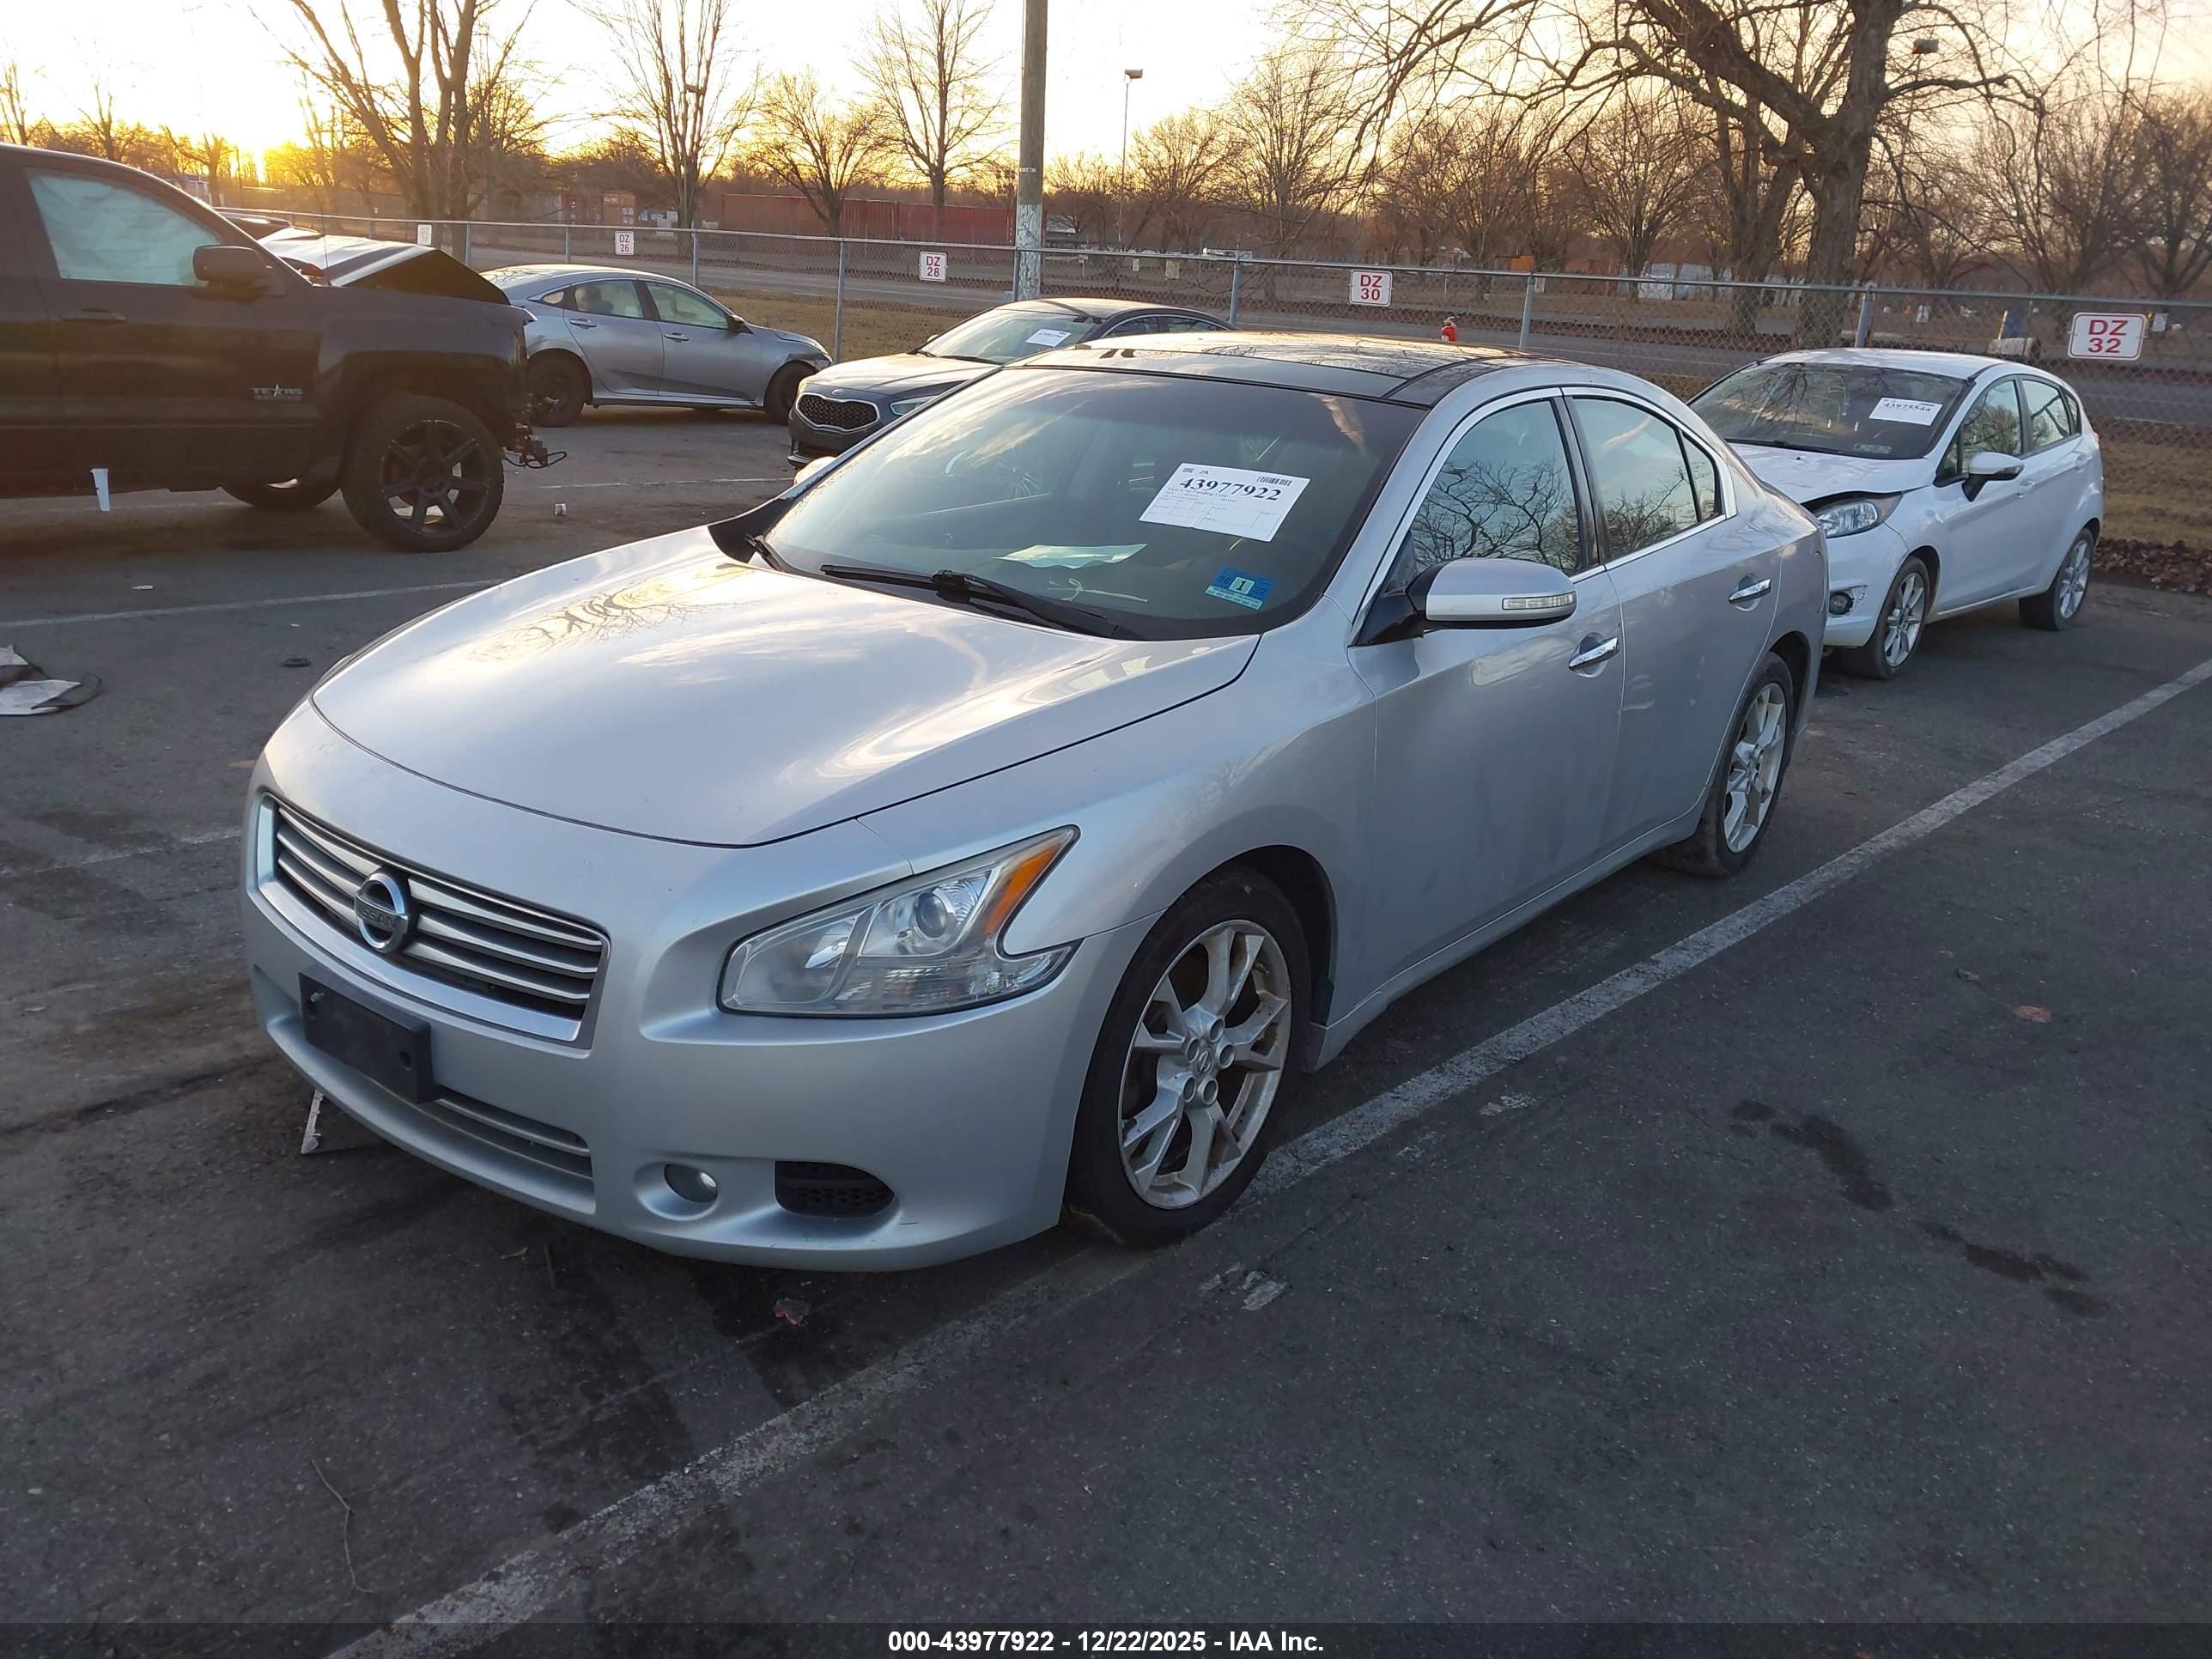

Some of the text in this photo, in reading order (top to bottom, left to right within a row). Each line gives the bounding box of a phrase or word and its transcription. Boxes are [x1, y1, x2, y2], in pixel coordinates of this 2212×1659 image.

[619, 234, 629, 243] DZ
[620, 243, 629, 252] 26
[927, 256, 940, 266] DZ
[927, 267, 939, 277] 28
[1360, 274, 1382, 288] DZ
[1360, 288, 1381, 301] 30
[2087, 319, 2129, 336] DZ
[2087, 337, 2122, 353] 32
[1179, 477, 1281, 501] 43977922
[1237, 580, 1247, 591] 1
